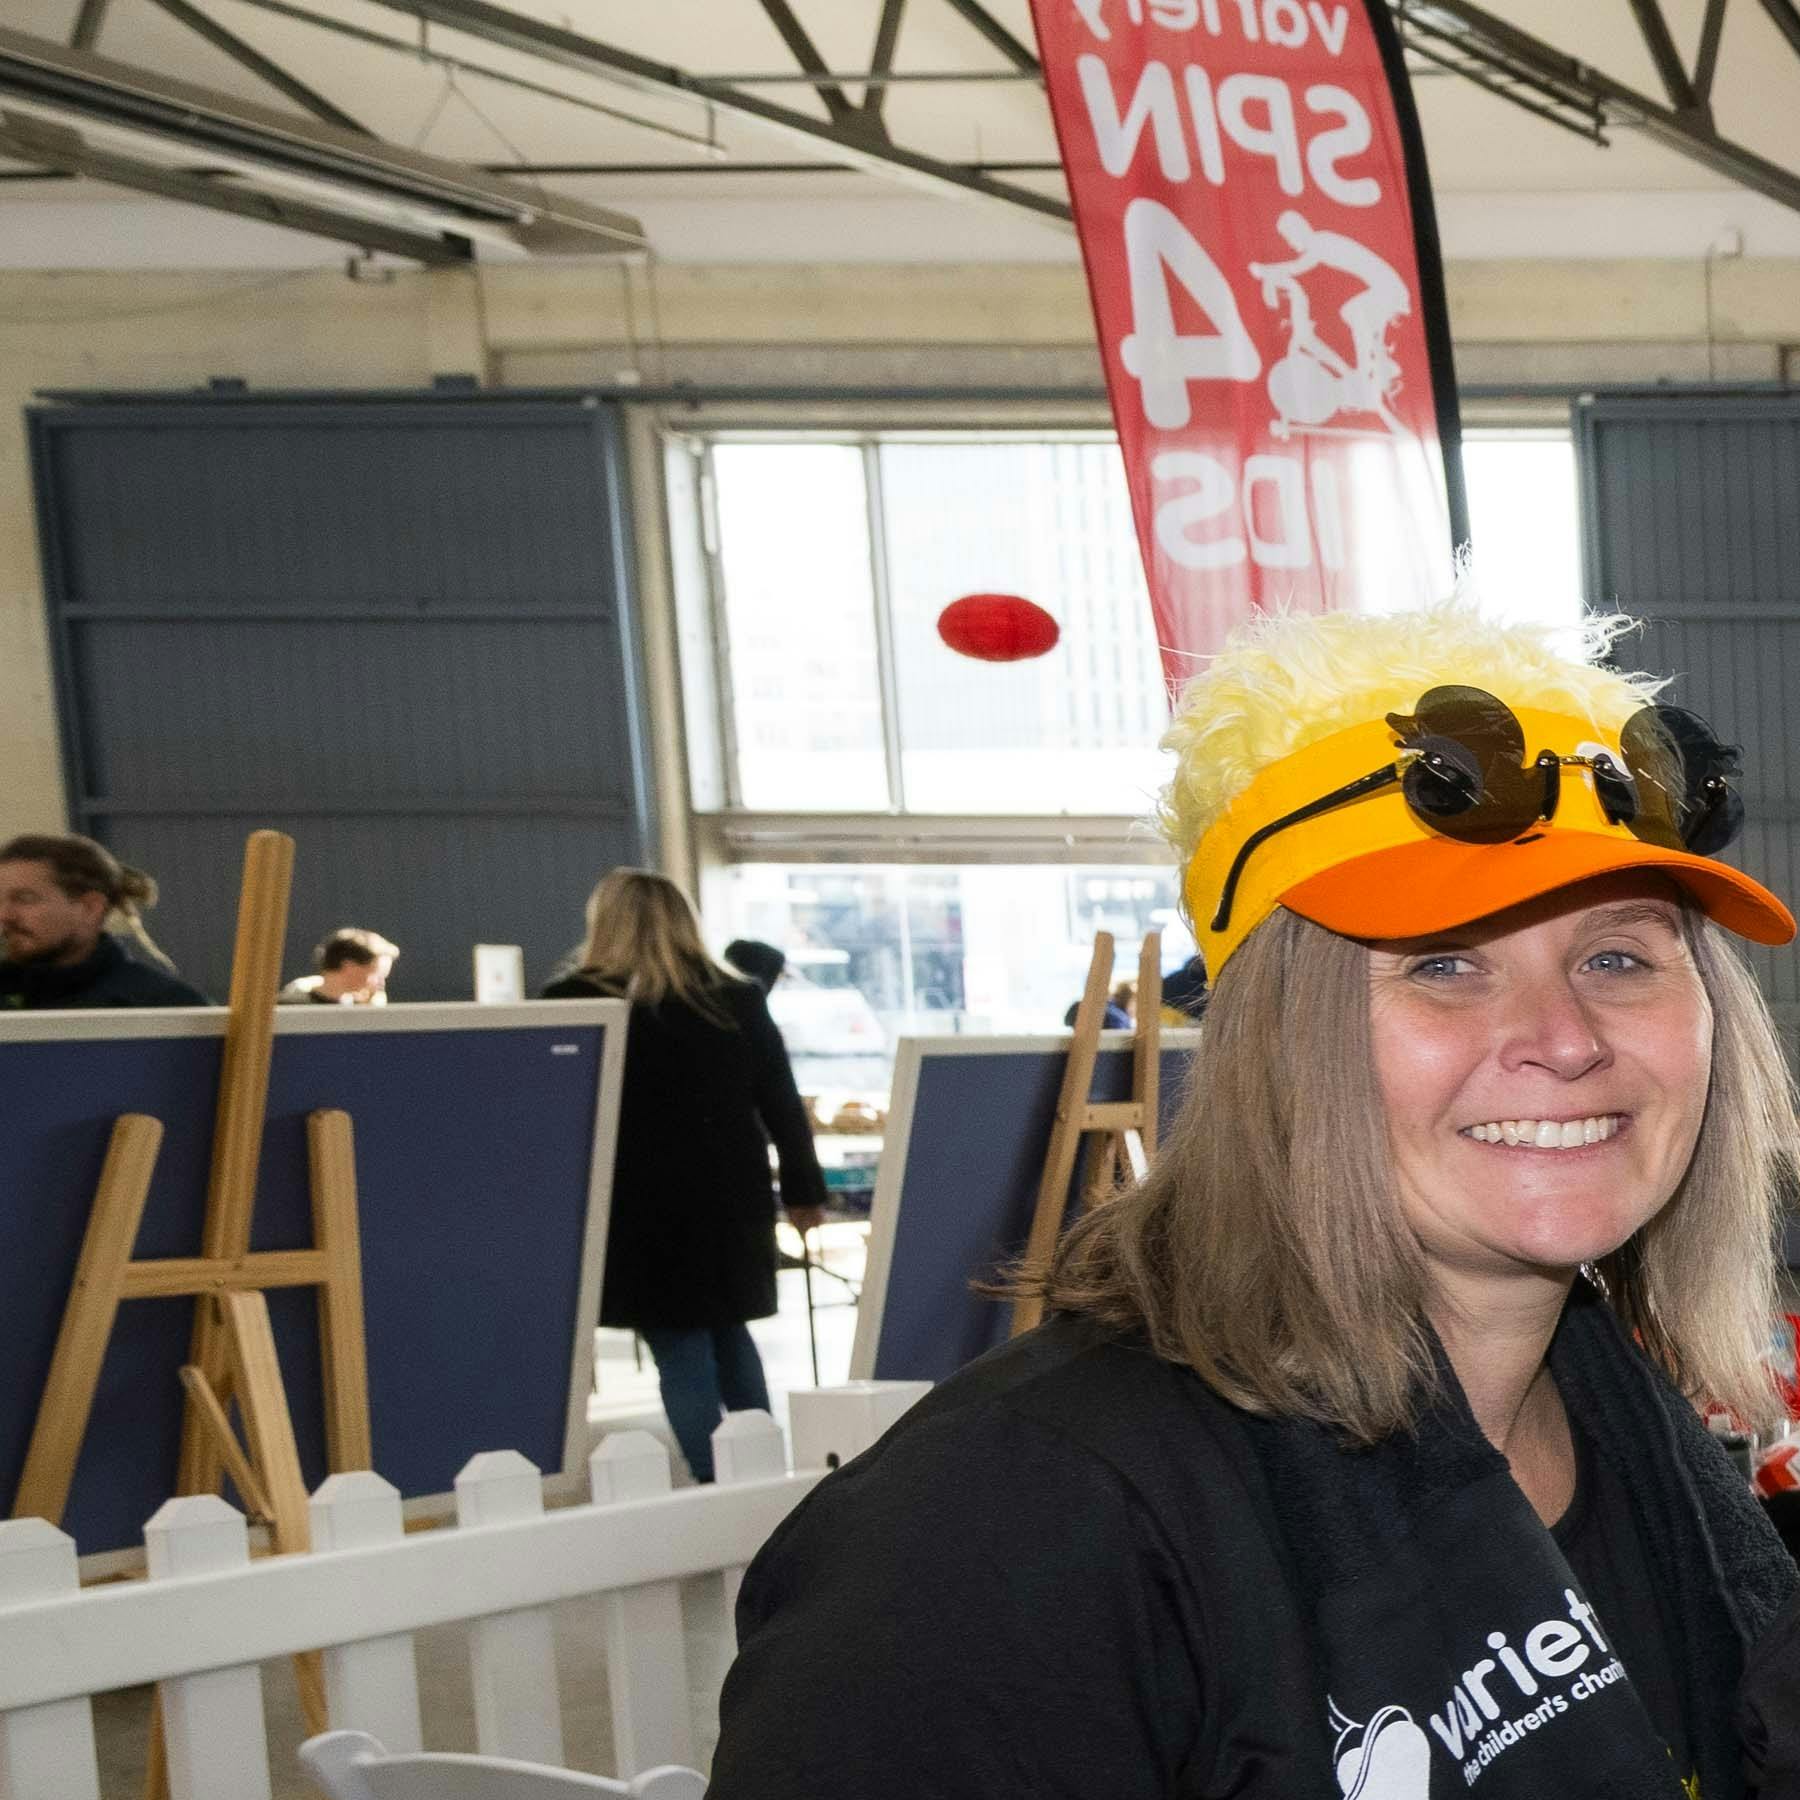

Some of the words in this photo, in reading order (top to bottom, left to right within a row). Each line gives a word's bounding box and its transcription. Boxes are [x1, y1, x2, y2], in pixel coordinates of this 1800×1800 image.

[1430, 1588, 1607, 1760] variet
[1463, 1758, 1482, 1787] the
[1478, 1694, 1569, 1766] children's
